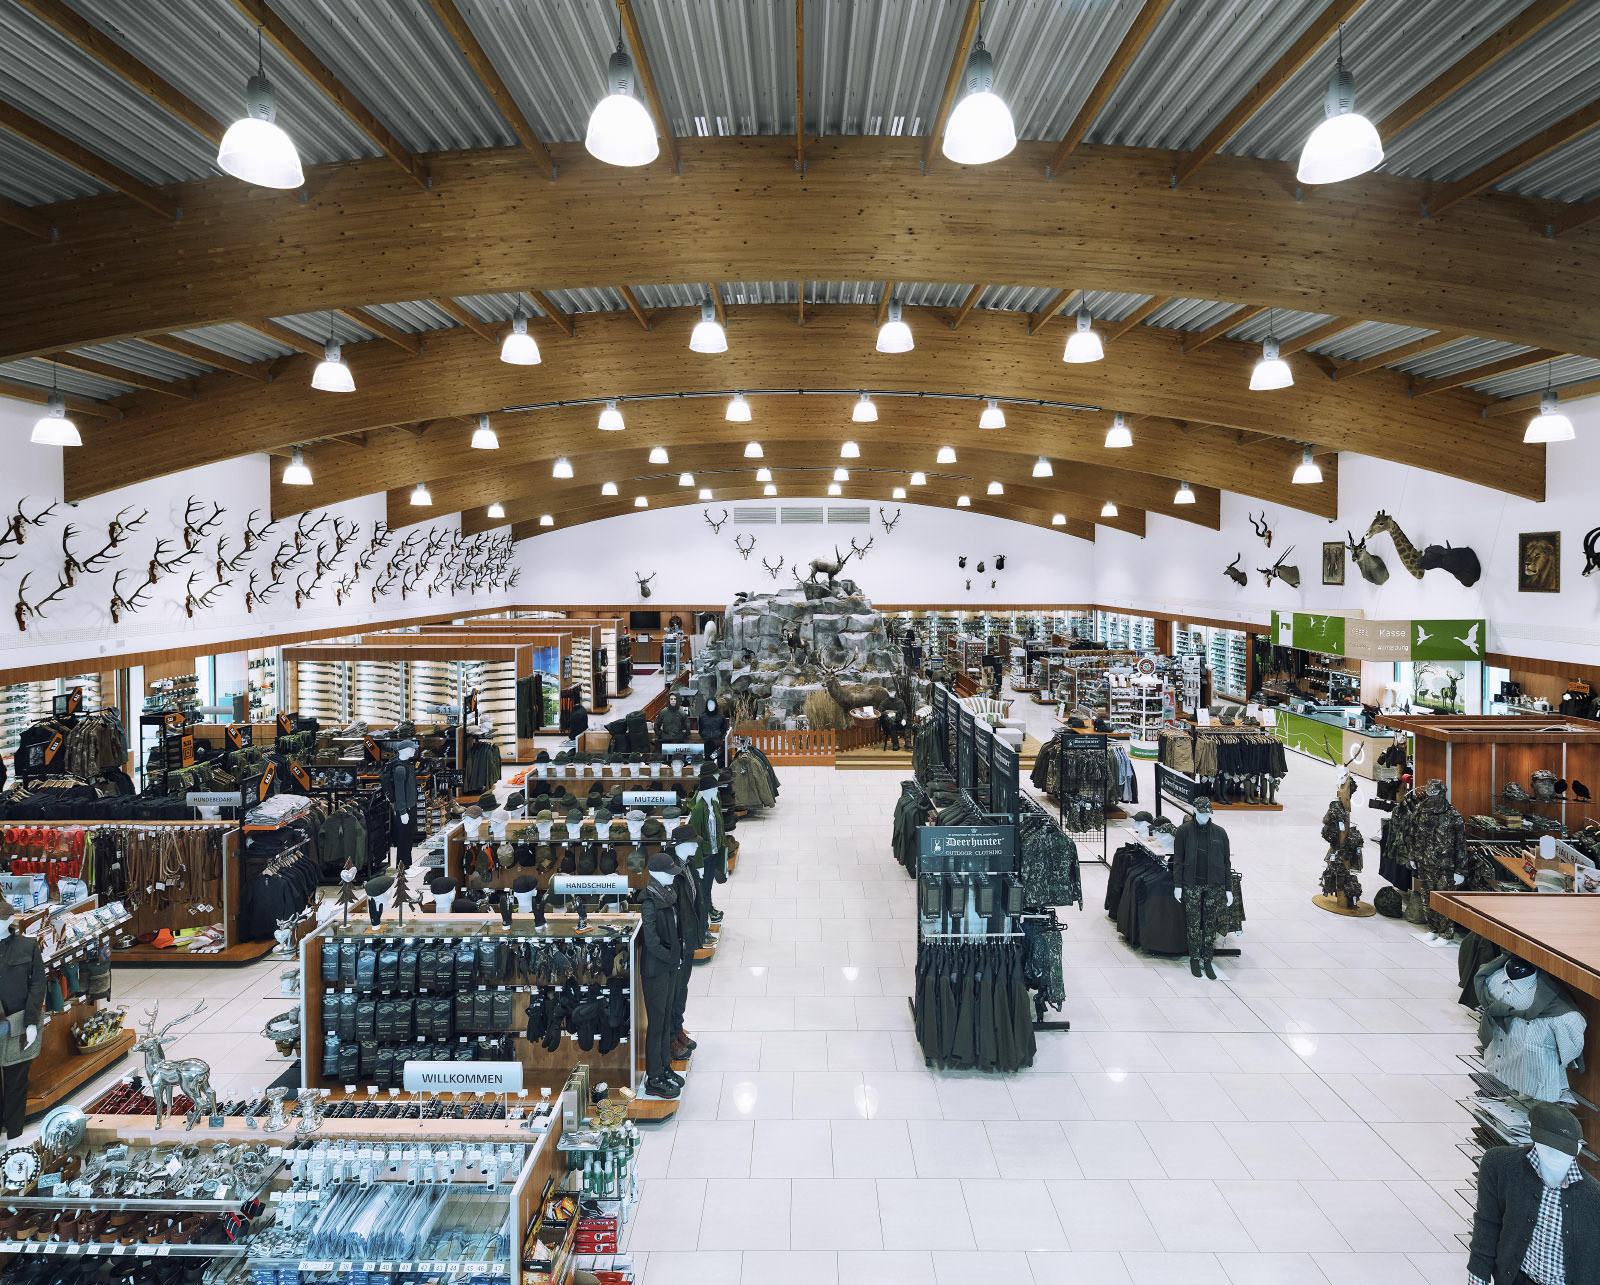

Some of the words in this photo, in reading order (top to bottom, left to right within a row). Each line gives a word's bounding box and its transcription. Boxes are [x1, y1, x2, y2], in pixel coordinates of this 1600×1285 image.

[1379, 629, 1406, 637] Kasse
[946, 837, 1003, 848] Deerhunter
[422, 1074, 503, 1084] WILLKOMMEN
